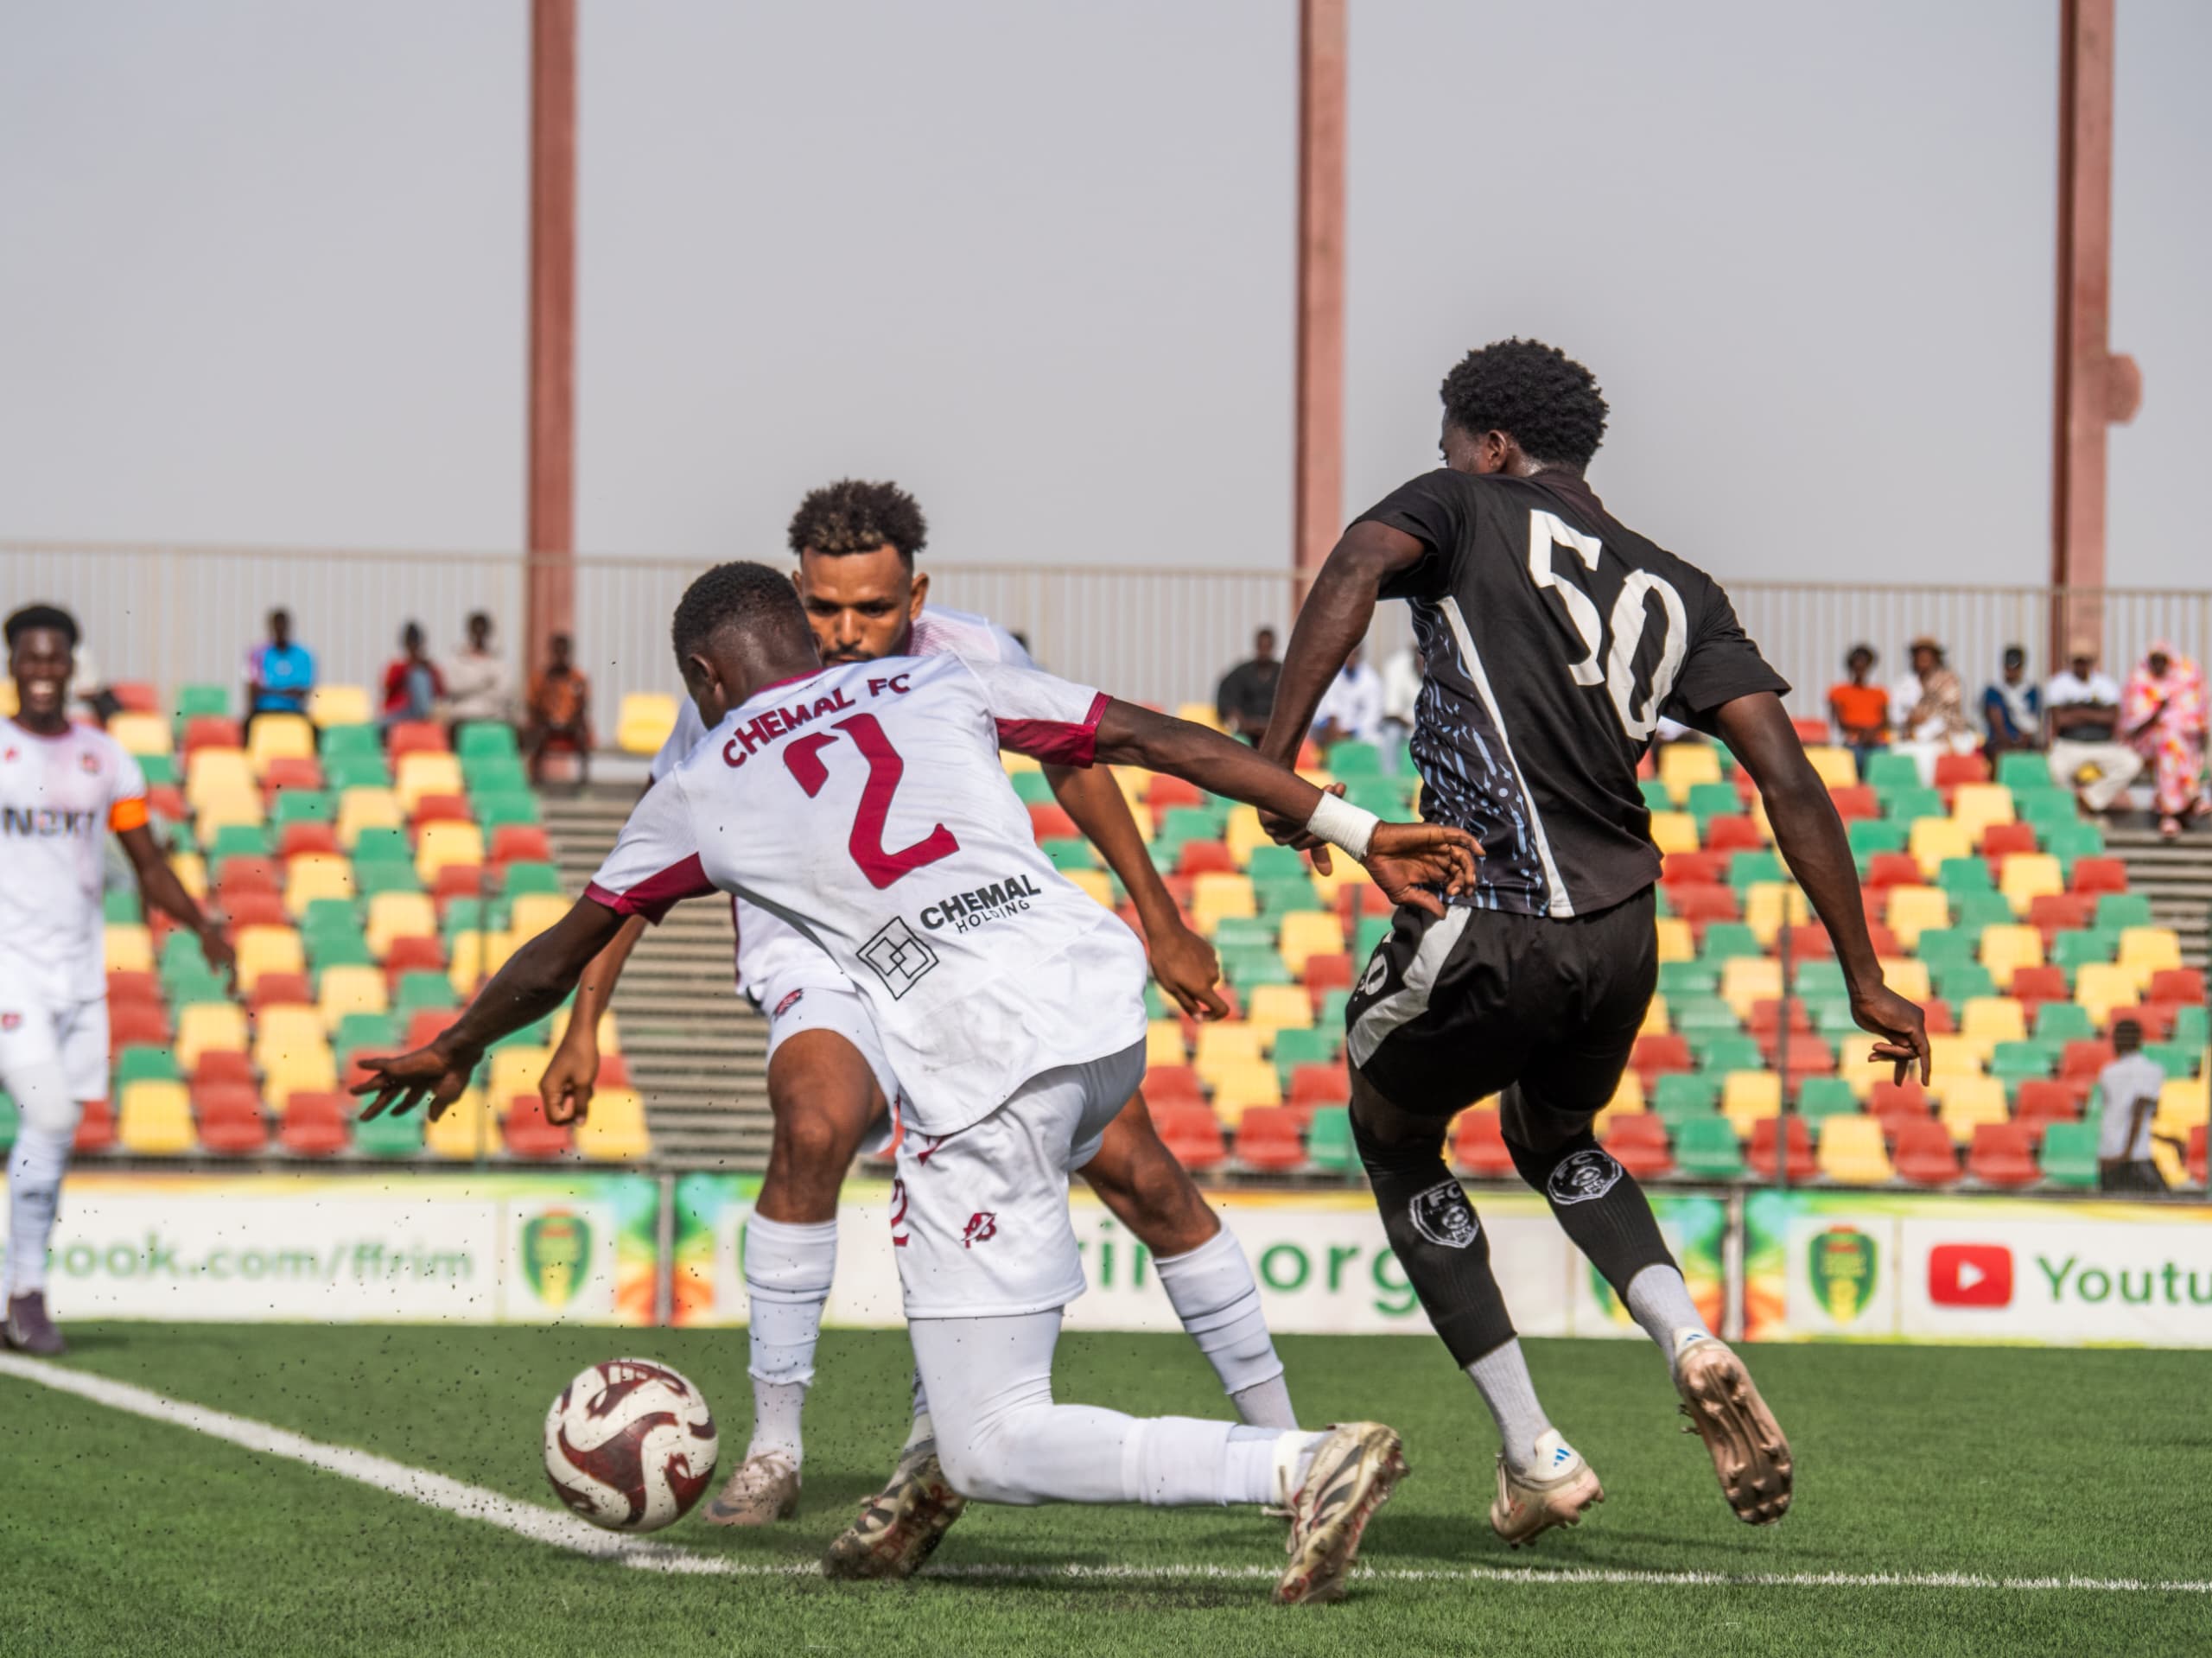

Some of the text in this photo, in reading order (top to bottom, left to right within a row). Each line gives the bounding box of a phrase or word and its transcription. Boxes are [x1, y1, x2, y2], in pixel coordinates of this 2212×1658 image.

[1529, 509, 1688, 741] 50
[722, 674, 910, 768] CHEMAL FC
[783, 713, 960, 890] 2
[919, 874, 1041, 931] CHEMAL
[955, 899, 1031, 934] HOLDING
[1427, 1183, 1462, 1207] FC
